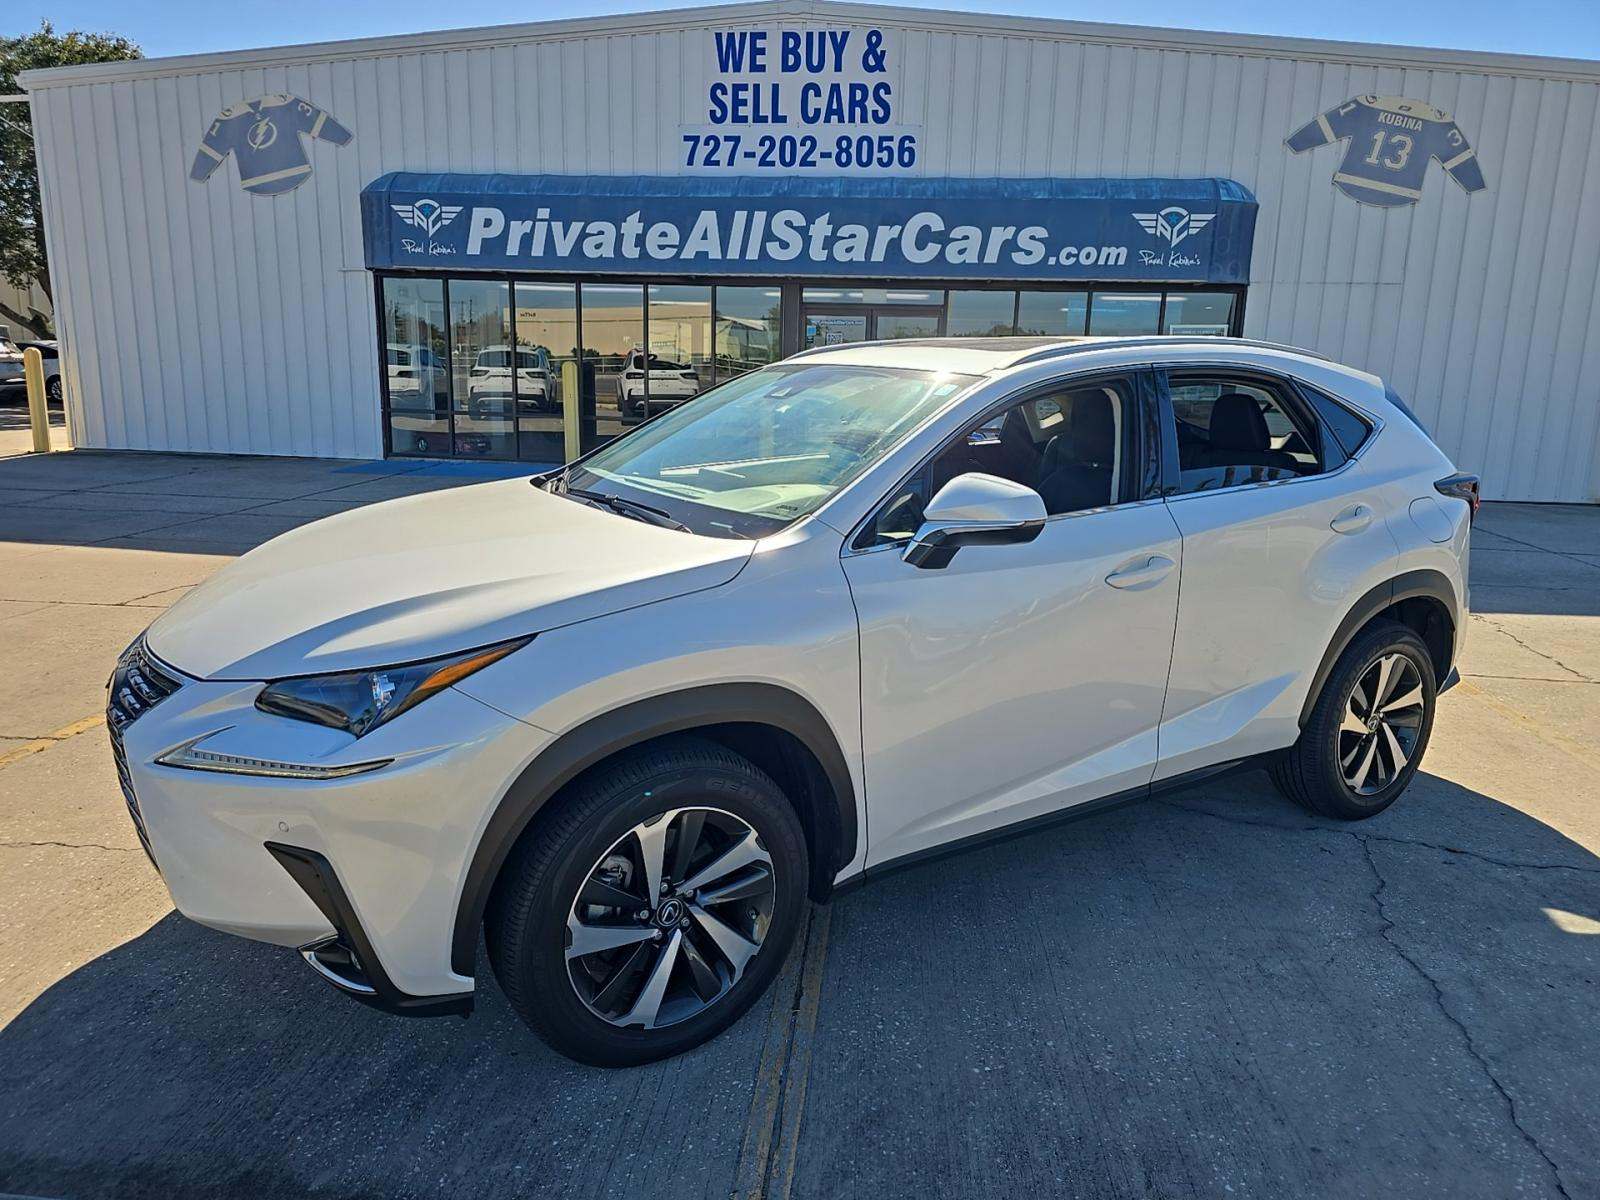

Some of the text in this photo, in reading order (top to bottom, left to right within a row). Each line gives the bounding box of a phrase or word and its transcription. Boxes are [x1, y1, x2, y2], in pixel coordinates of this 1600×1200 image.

[714, 29, 887, 73] WE BUY &
[709, 81, 892, 125] SELL CARS
[1377, 111, 1424, 132] KUBINA
[682, 134, 917, 168] 727-202-8056
[1365, 130, 1415, 170] 13
